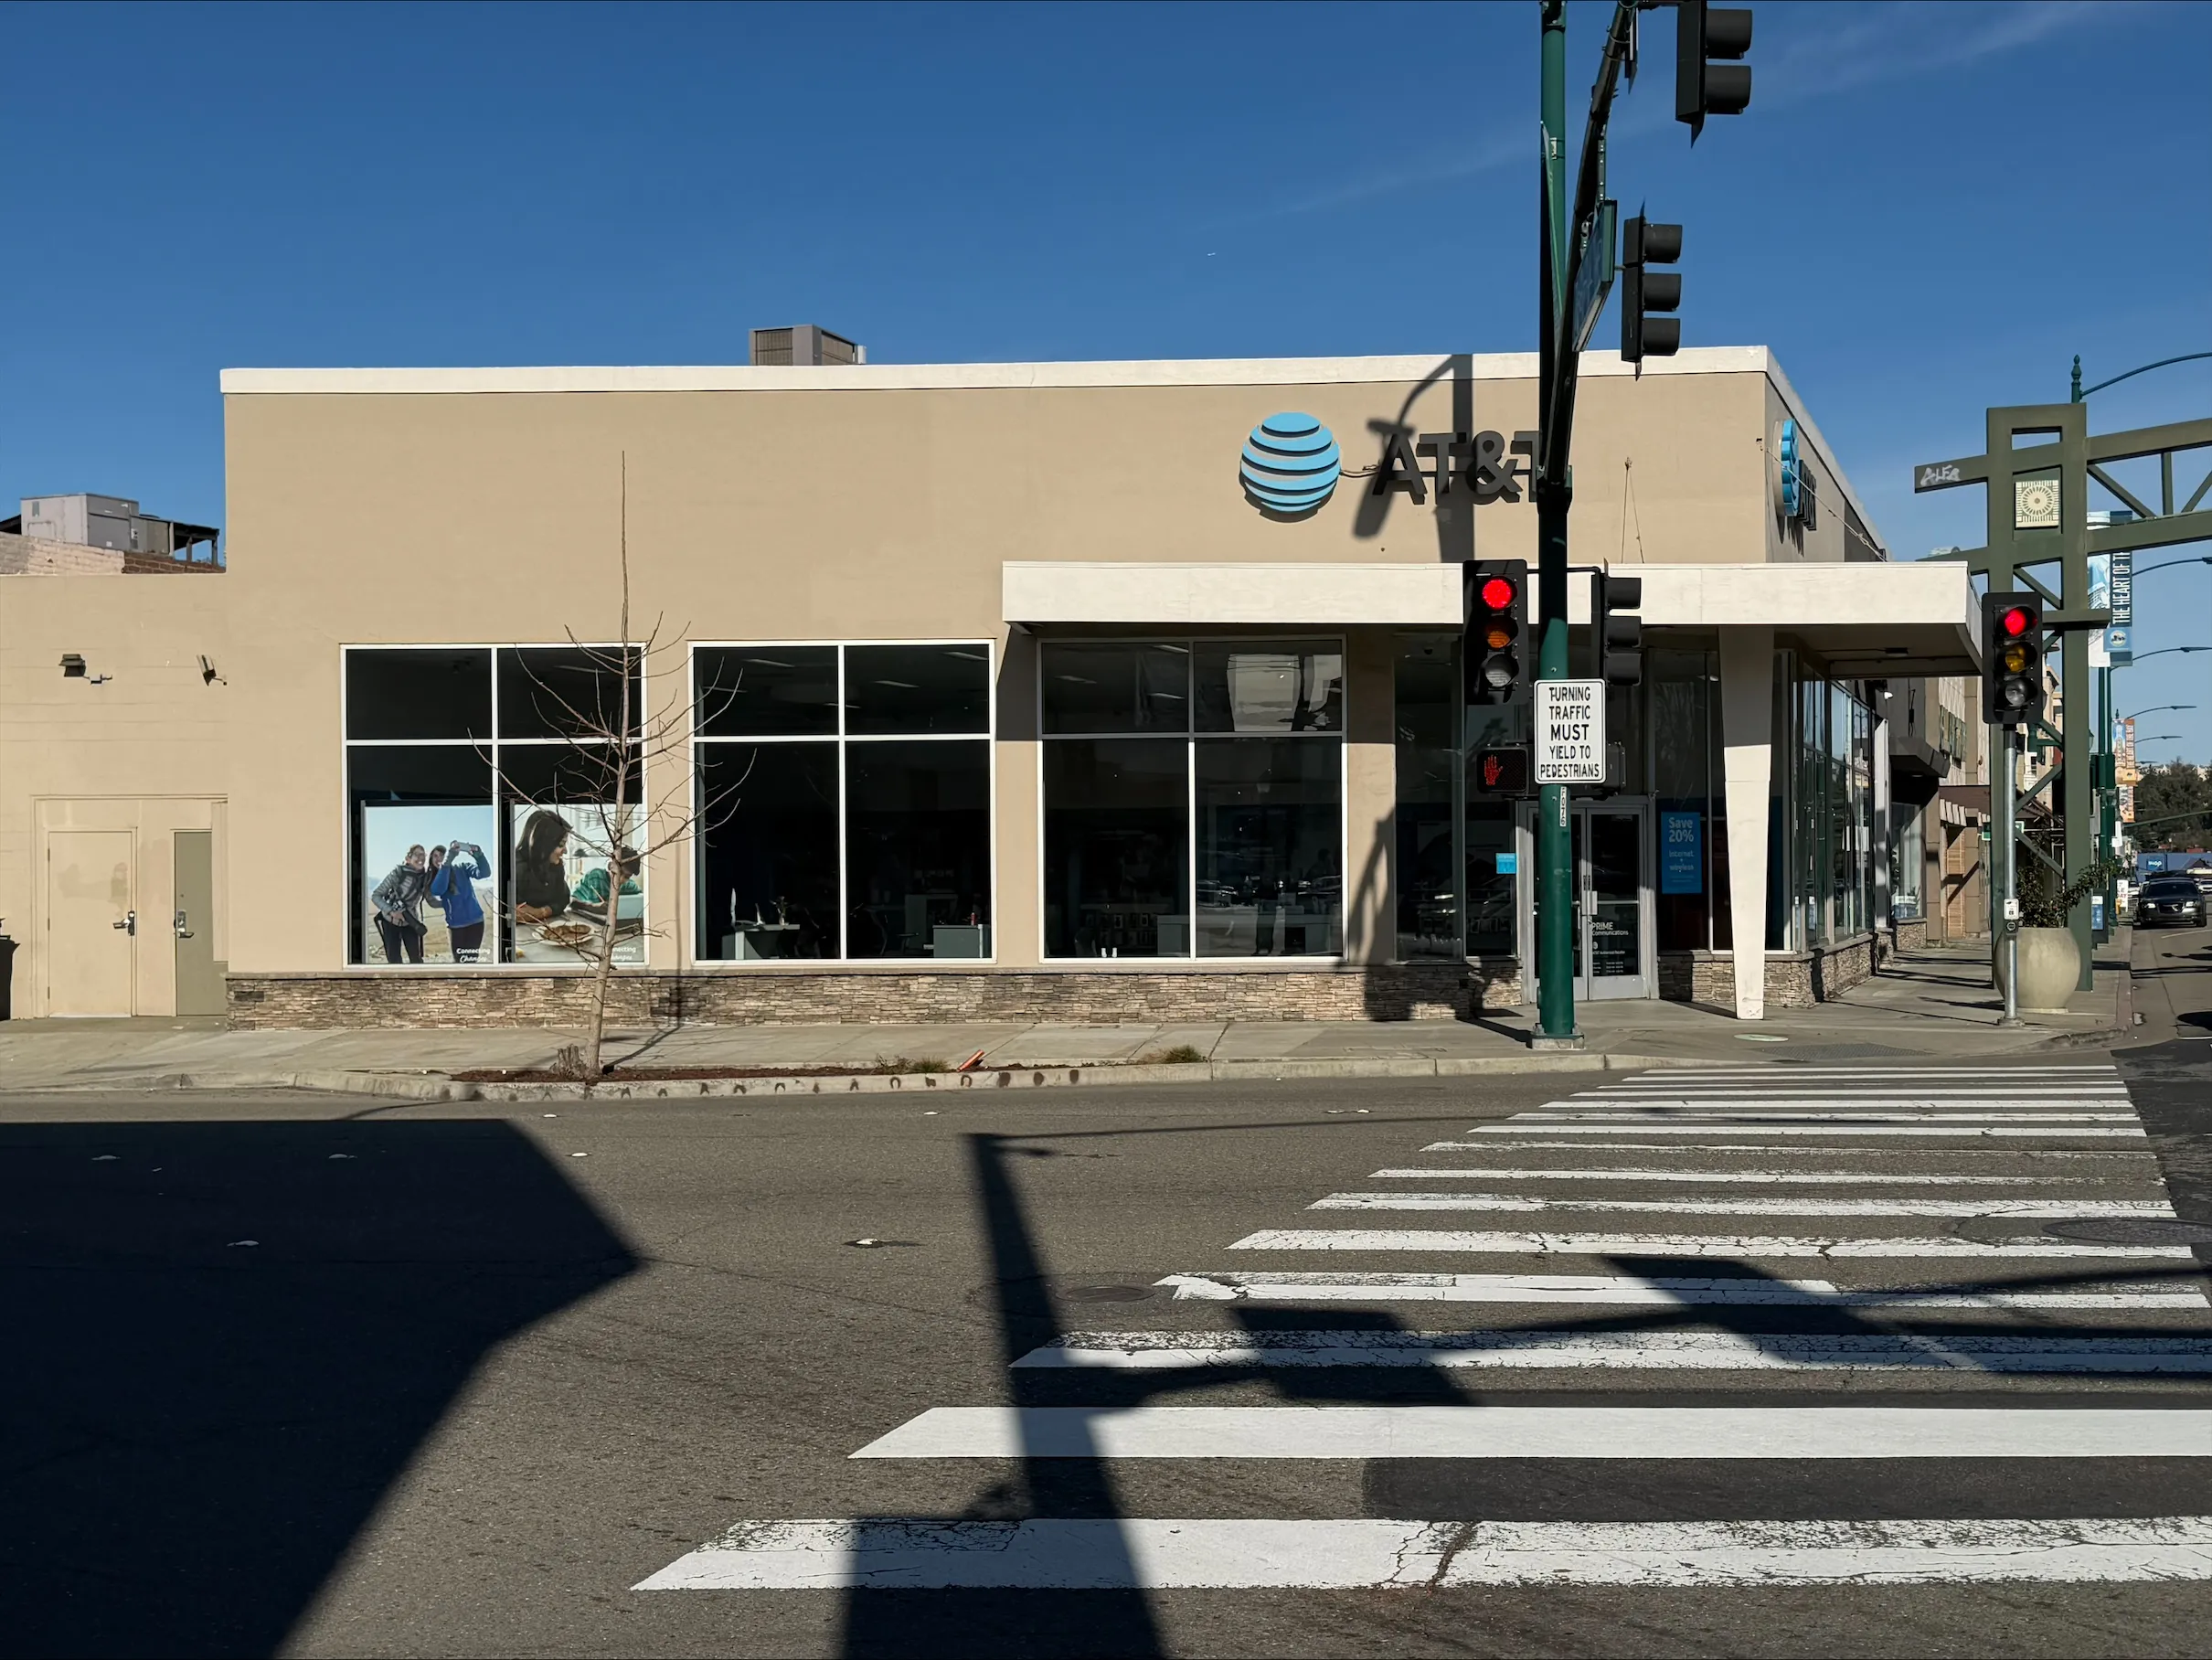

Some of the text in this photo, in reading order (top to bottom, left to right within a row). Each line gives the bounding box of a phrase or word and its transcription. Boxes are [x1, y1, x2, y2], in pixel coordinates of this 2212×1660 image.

[2112, 563, 2131, 575] OF
[2112, 577, 2131, 605] HEART
[2112, 607, 2131, 624] THE
[1548, 686, 1590, 702] TURNING
[1548, 705, 1590, 720] TRAFFIC
[1550, 724, 1590, 740] MUST
[1549, 745, 1591, 760] YIELD TO
[1540, 763, 1600, 778] PEDESTRIANS
[1669, 817, 1694, 829] Save
[1669, 829, 1694, 842] 20%
[1591, 922, 1613, 931] PRIME
